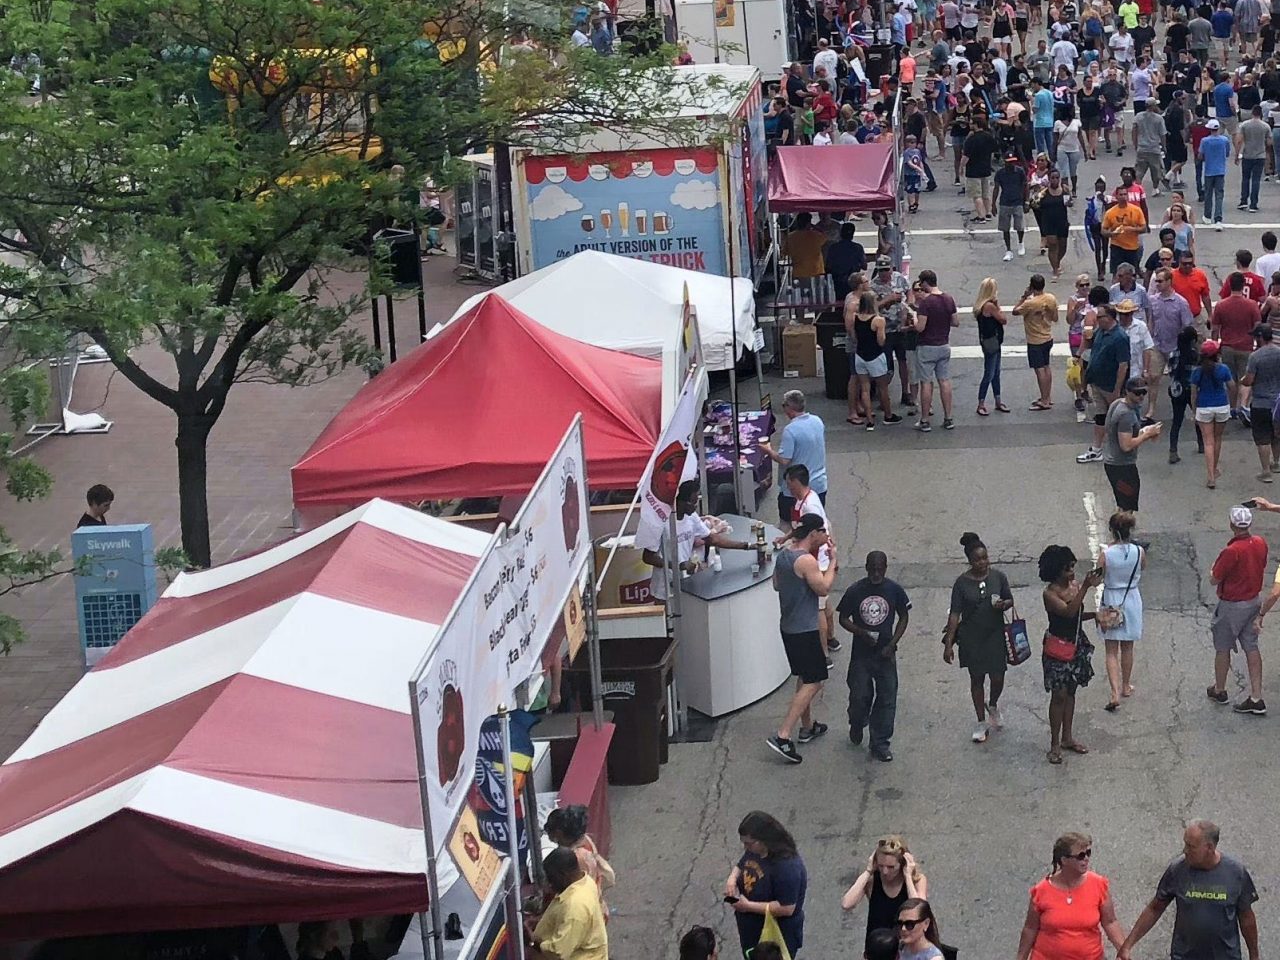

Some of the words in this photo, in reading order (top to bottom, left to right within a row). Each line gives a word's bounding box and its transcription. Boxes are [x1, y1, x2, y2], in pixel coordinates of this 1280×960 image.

[556, 248, 571, 258] the
[574, 242, 607, 254] ADULT
[610, 241, 656, 255] VERSION
[660, 239, 674, 251] OF
[676, 237, 698, 249] THE
[650, 251, 707, 271] TRUCK
[87, 539, 131, 551] Skywalk
[624, 586, 650, 603] Lip
[1185, 890, 1227, 900] ARMOUR
